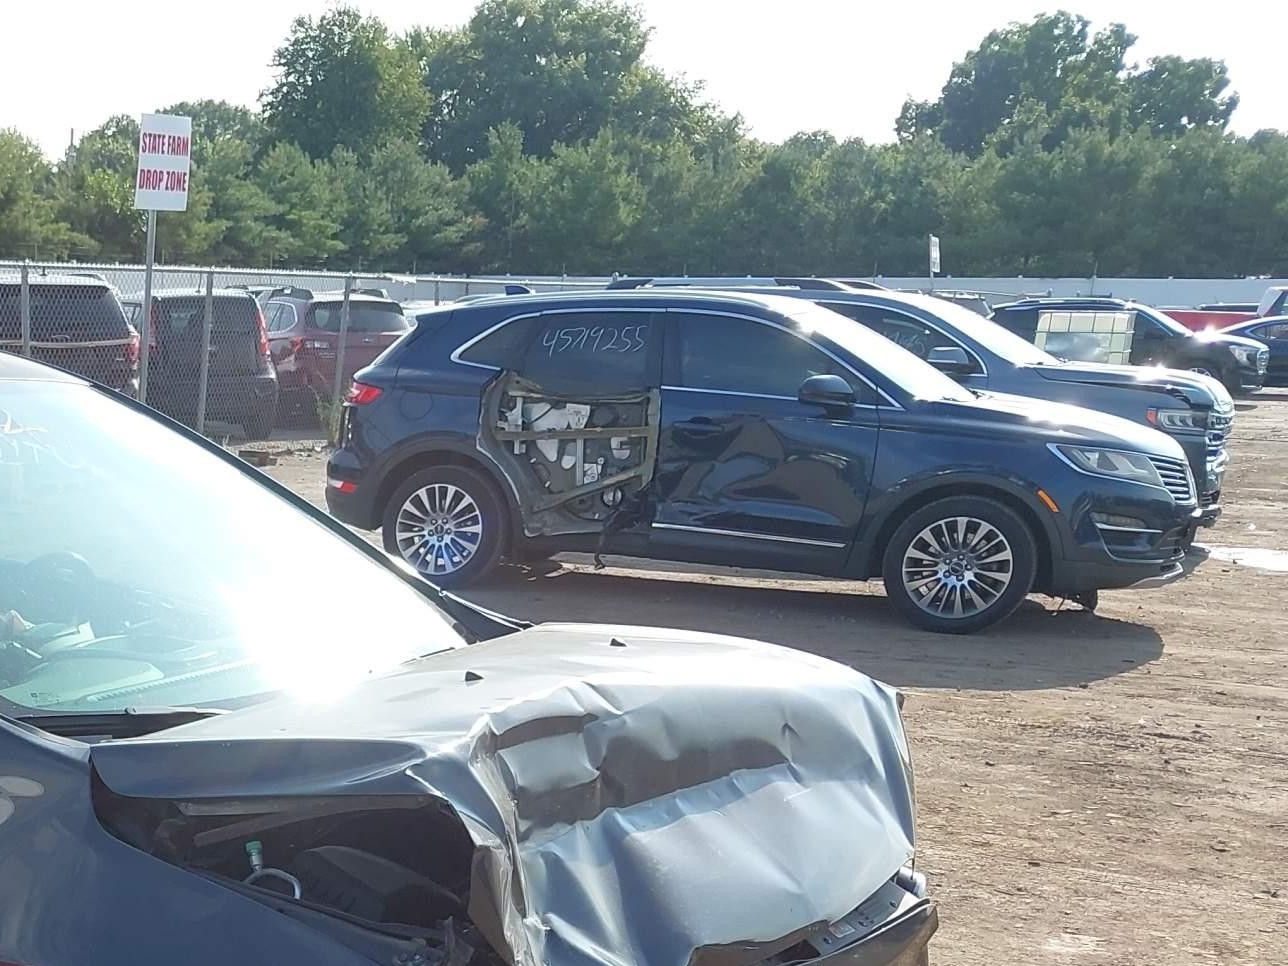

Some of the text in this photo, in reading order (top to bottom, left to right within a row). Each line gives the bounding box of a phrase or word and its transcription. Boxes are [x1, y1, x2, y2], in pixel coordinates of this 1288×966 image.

[142, 132, 189, 156] STATE FARM
[139, 169, 187, 192] DROP ZONE
[543, 325, 648, 358] 45719255
